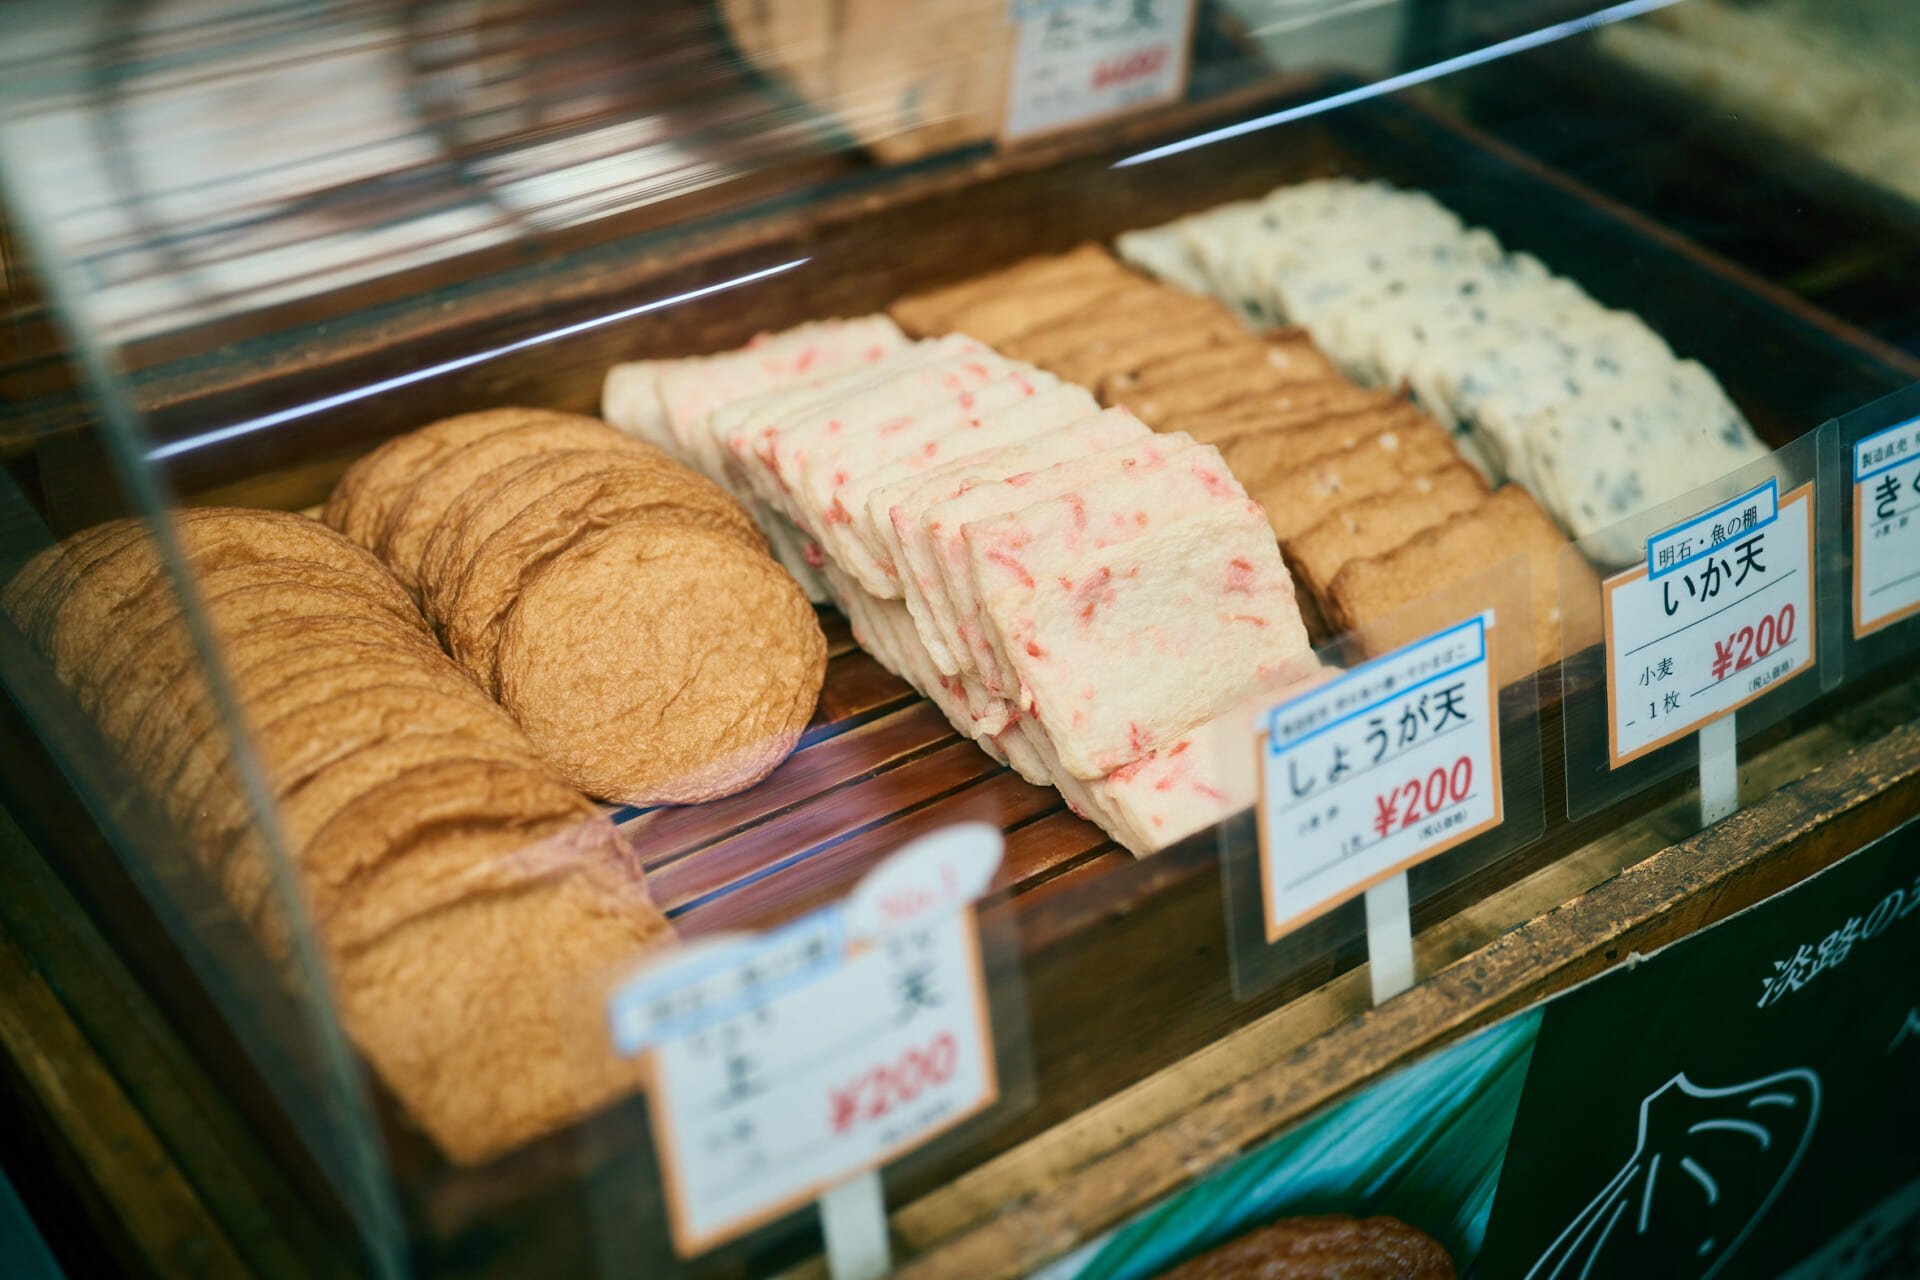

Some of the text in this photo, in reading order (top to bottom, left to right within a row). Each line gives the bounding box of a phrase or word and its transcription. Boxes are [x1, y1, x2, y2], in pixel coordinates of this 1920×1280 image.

[1663, 532, 1766, 616] いか天
[1639, 657, 1674, 686] 小麦
[1711, 602, 1796, 681] ¥200
[1288, 681, 1467, 798] しょうが天
[1373, 755, 1474, 839] ¥200
[828, 1029, 960, 1137] ¥200
